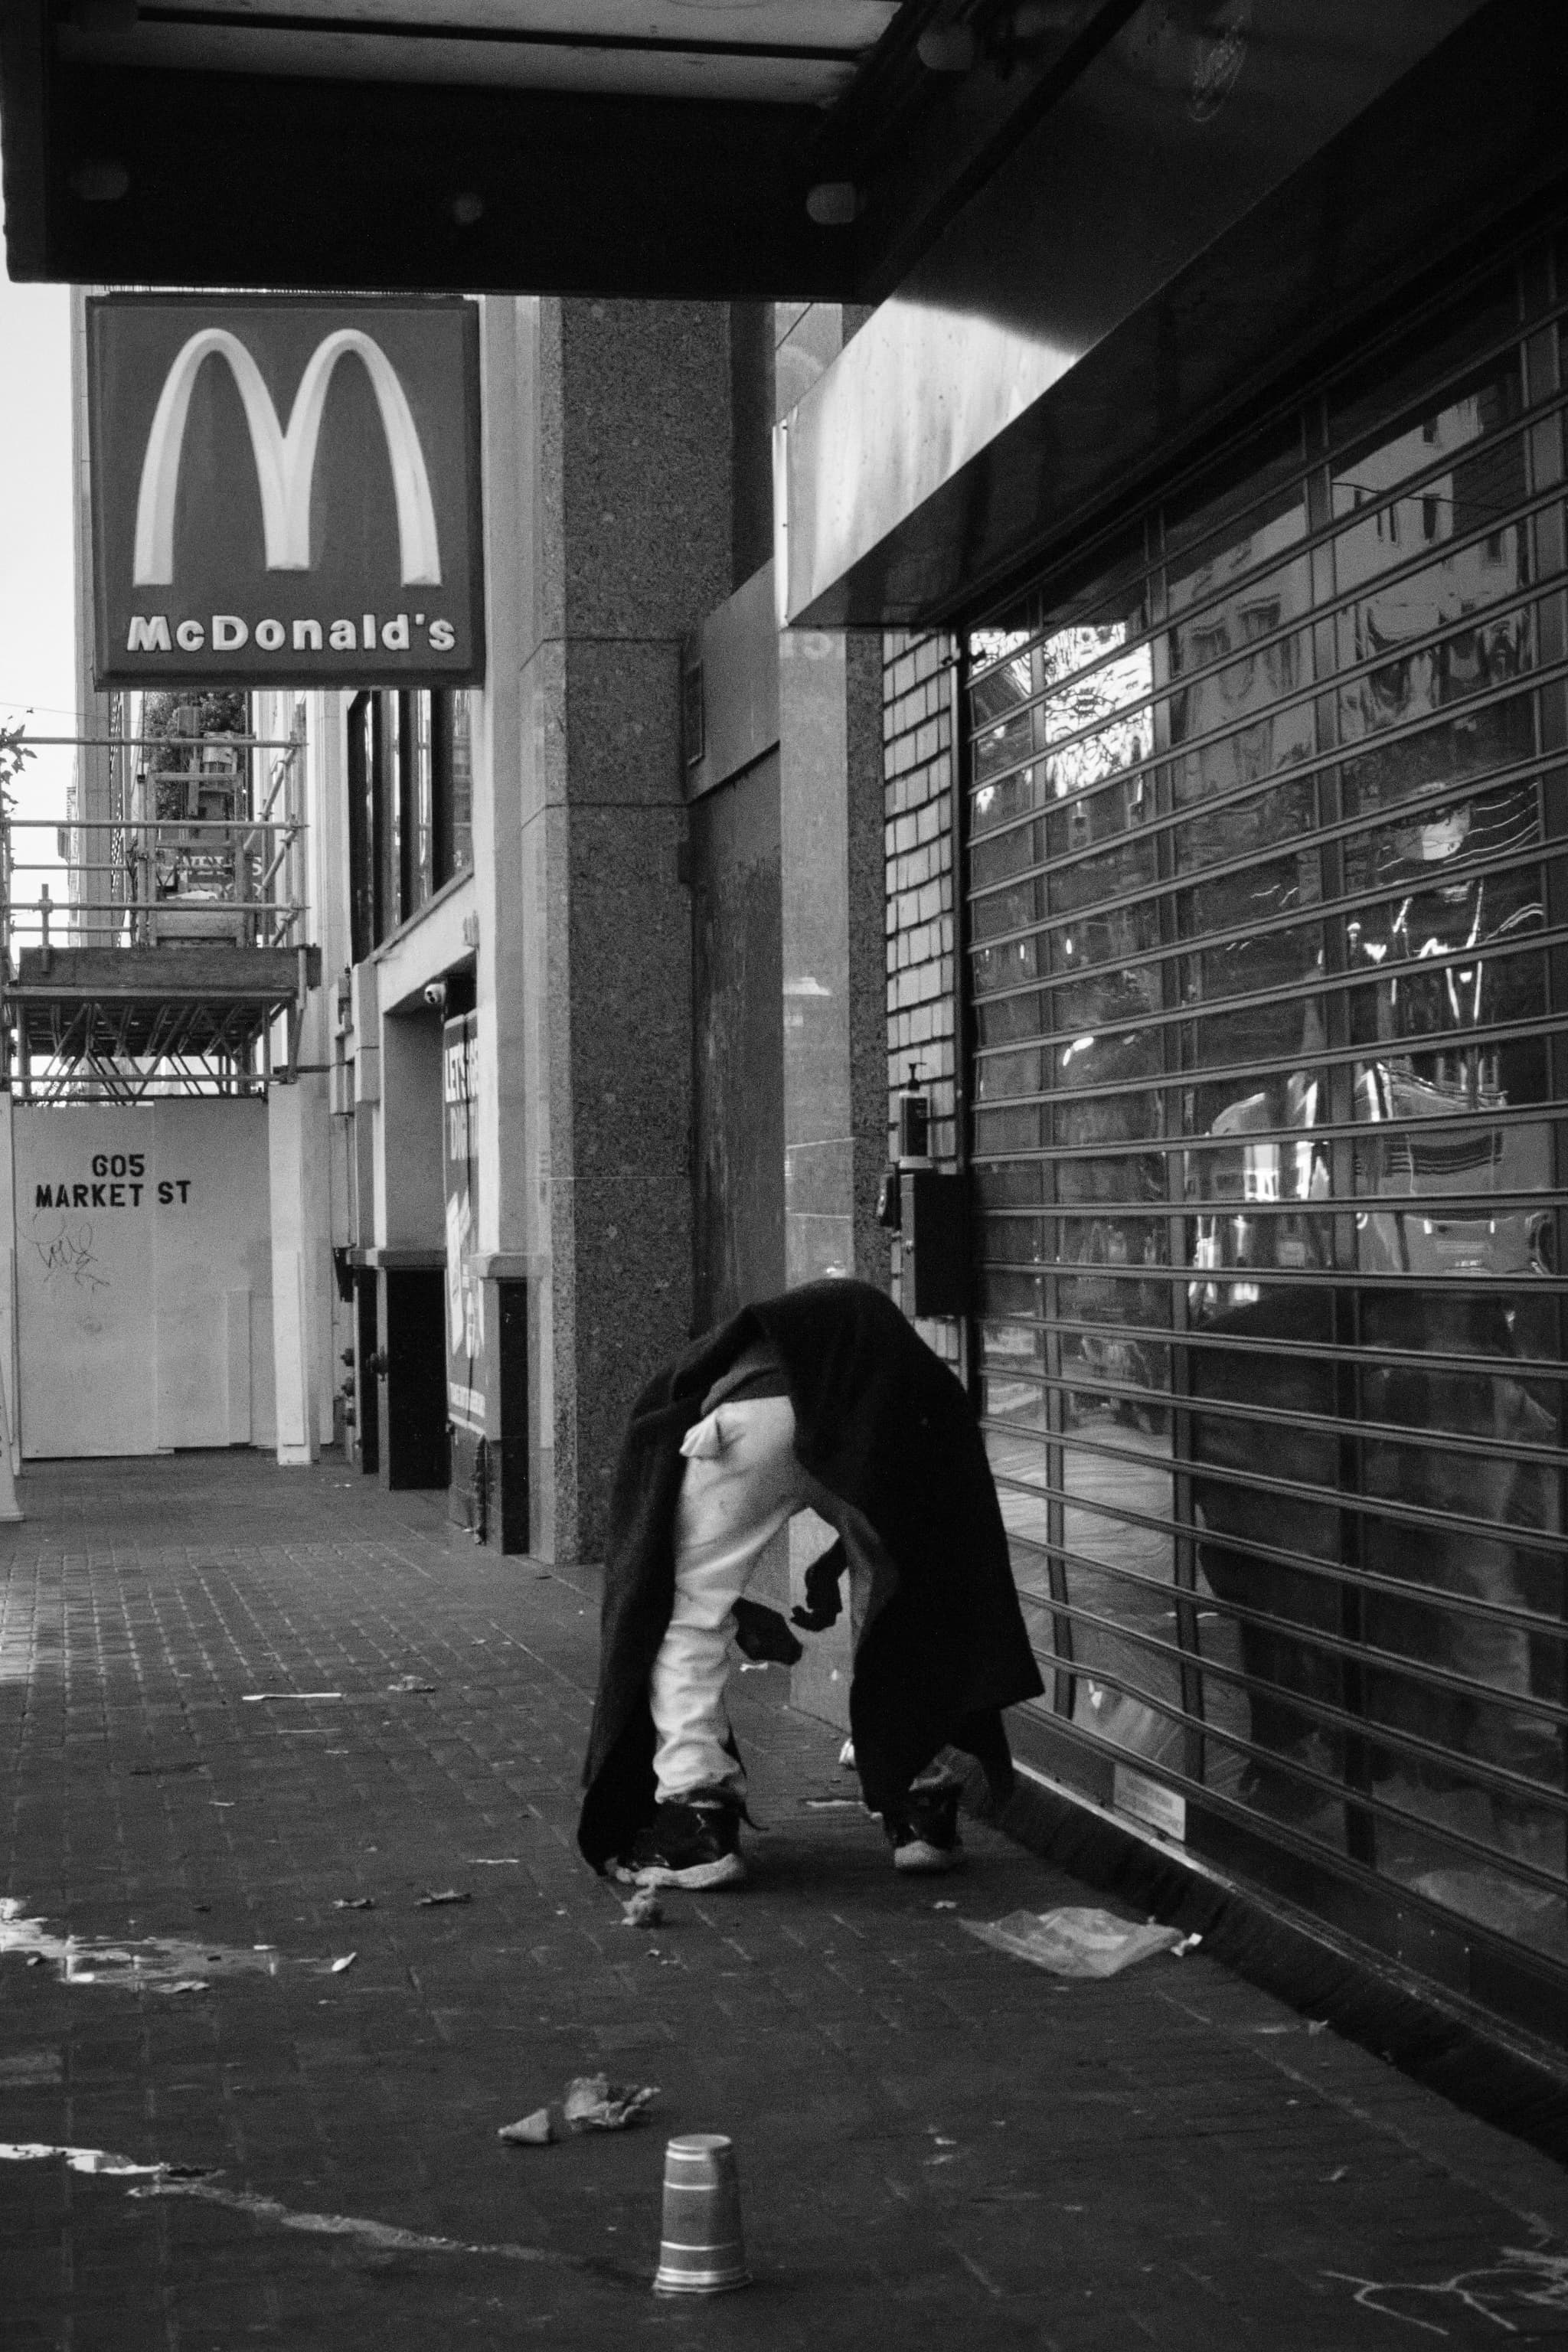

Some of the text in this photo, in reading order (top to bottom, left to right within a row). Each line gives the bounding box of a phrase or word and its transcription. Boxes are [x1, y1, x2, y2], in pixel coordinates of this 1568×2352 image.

[126, 613, 456, 652] McDonald's
[91, 1153, 145, 1178] 605
[35, 1179, 192, 1208] MARKET ST
